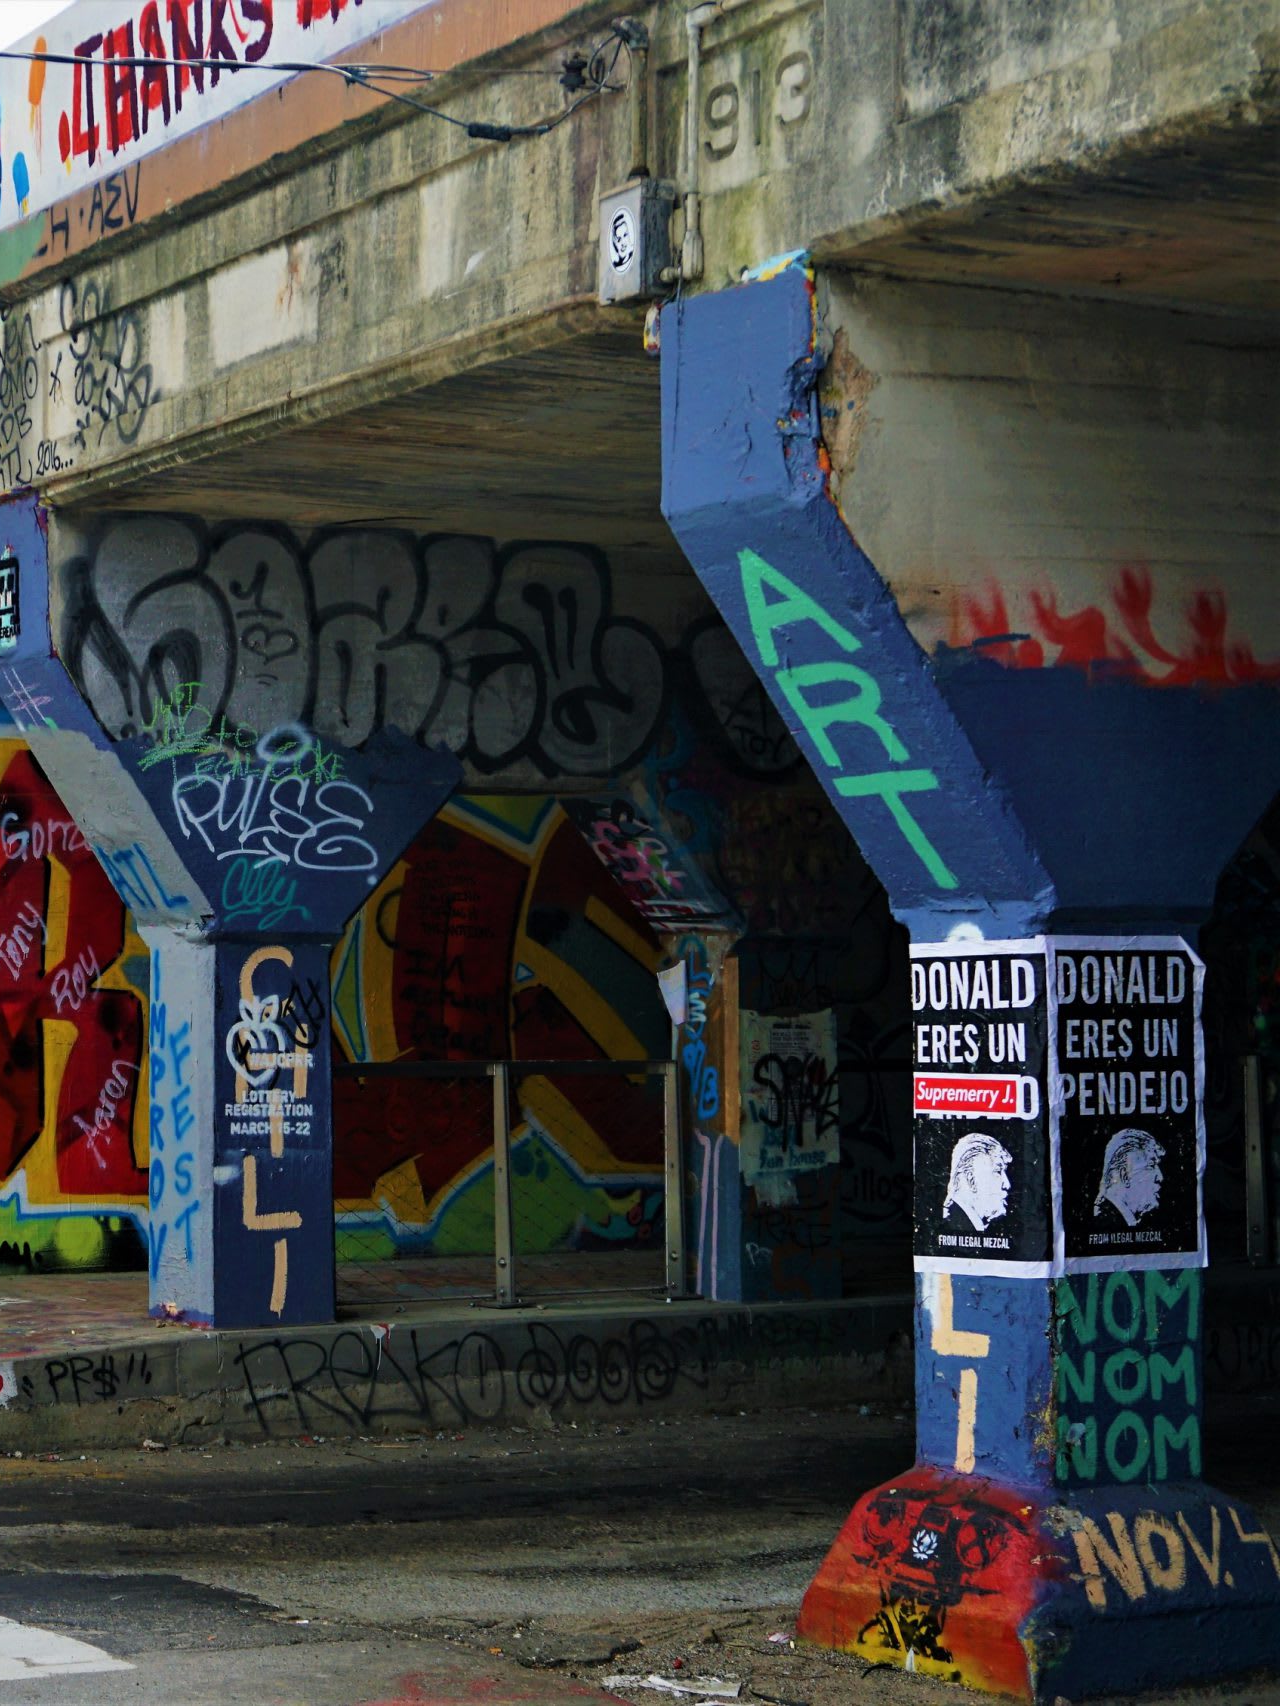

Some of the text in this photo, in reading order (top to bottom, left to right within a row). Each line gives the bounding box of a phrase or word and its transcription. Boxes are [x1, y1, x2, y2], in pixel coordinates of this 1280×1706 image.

[737, 546, 959, 890] ART
[910, 958, 1036, 1012] DONALD
[1056, 955, 1186, 1006] DONALD
[916, 1022, 1027, 1064] ERES UN
[1066, 1018, 1179, 1059] ERES UN
[224, 1103, 314, 1117] REGISTRATION
[241, 1089, 296, 1103] LOTTERY
[916, 1081, 1000, 1109] Supremerry
[1001, 1084, 1014, 1104] J.
[1062, 1070, 1189, 1117] PENDEJO
[229, 1121, 271, 1136] MARCH
[938, 1234, 959, 1247] FROM
[982, 1236, 1010, 1249] MEZCAL
[1088, 1234, 1109, 1245] FROM
[1134, 1231, 1163, 1242] MEZCAL
[1054, 1270, 1202, 1345] NOM
[1057, 1345, 1197, 1407] NOM
[1054, 1409, 1203, 1482] NOM
[1071, 1504, 1235, 1615] NOV.
